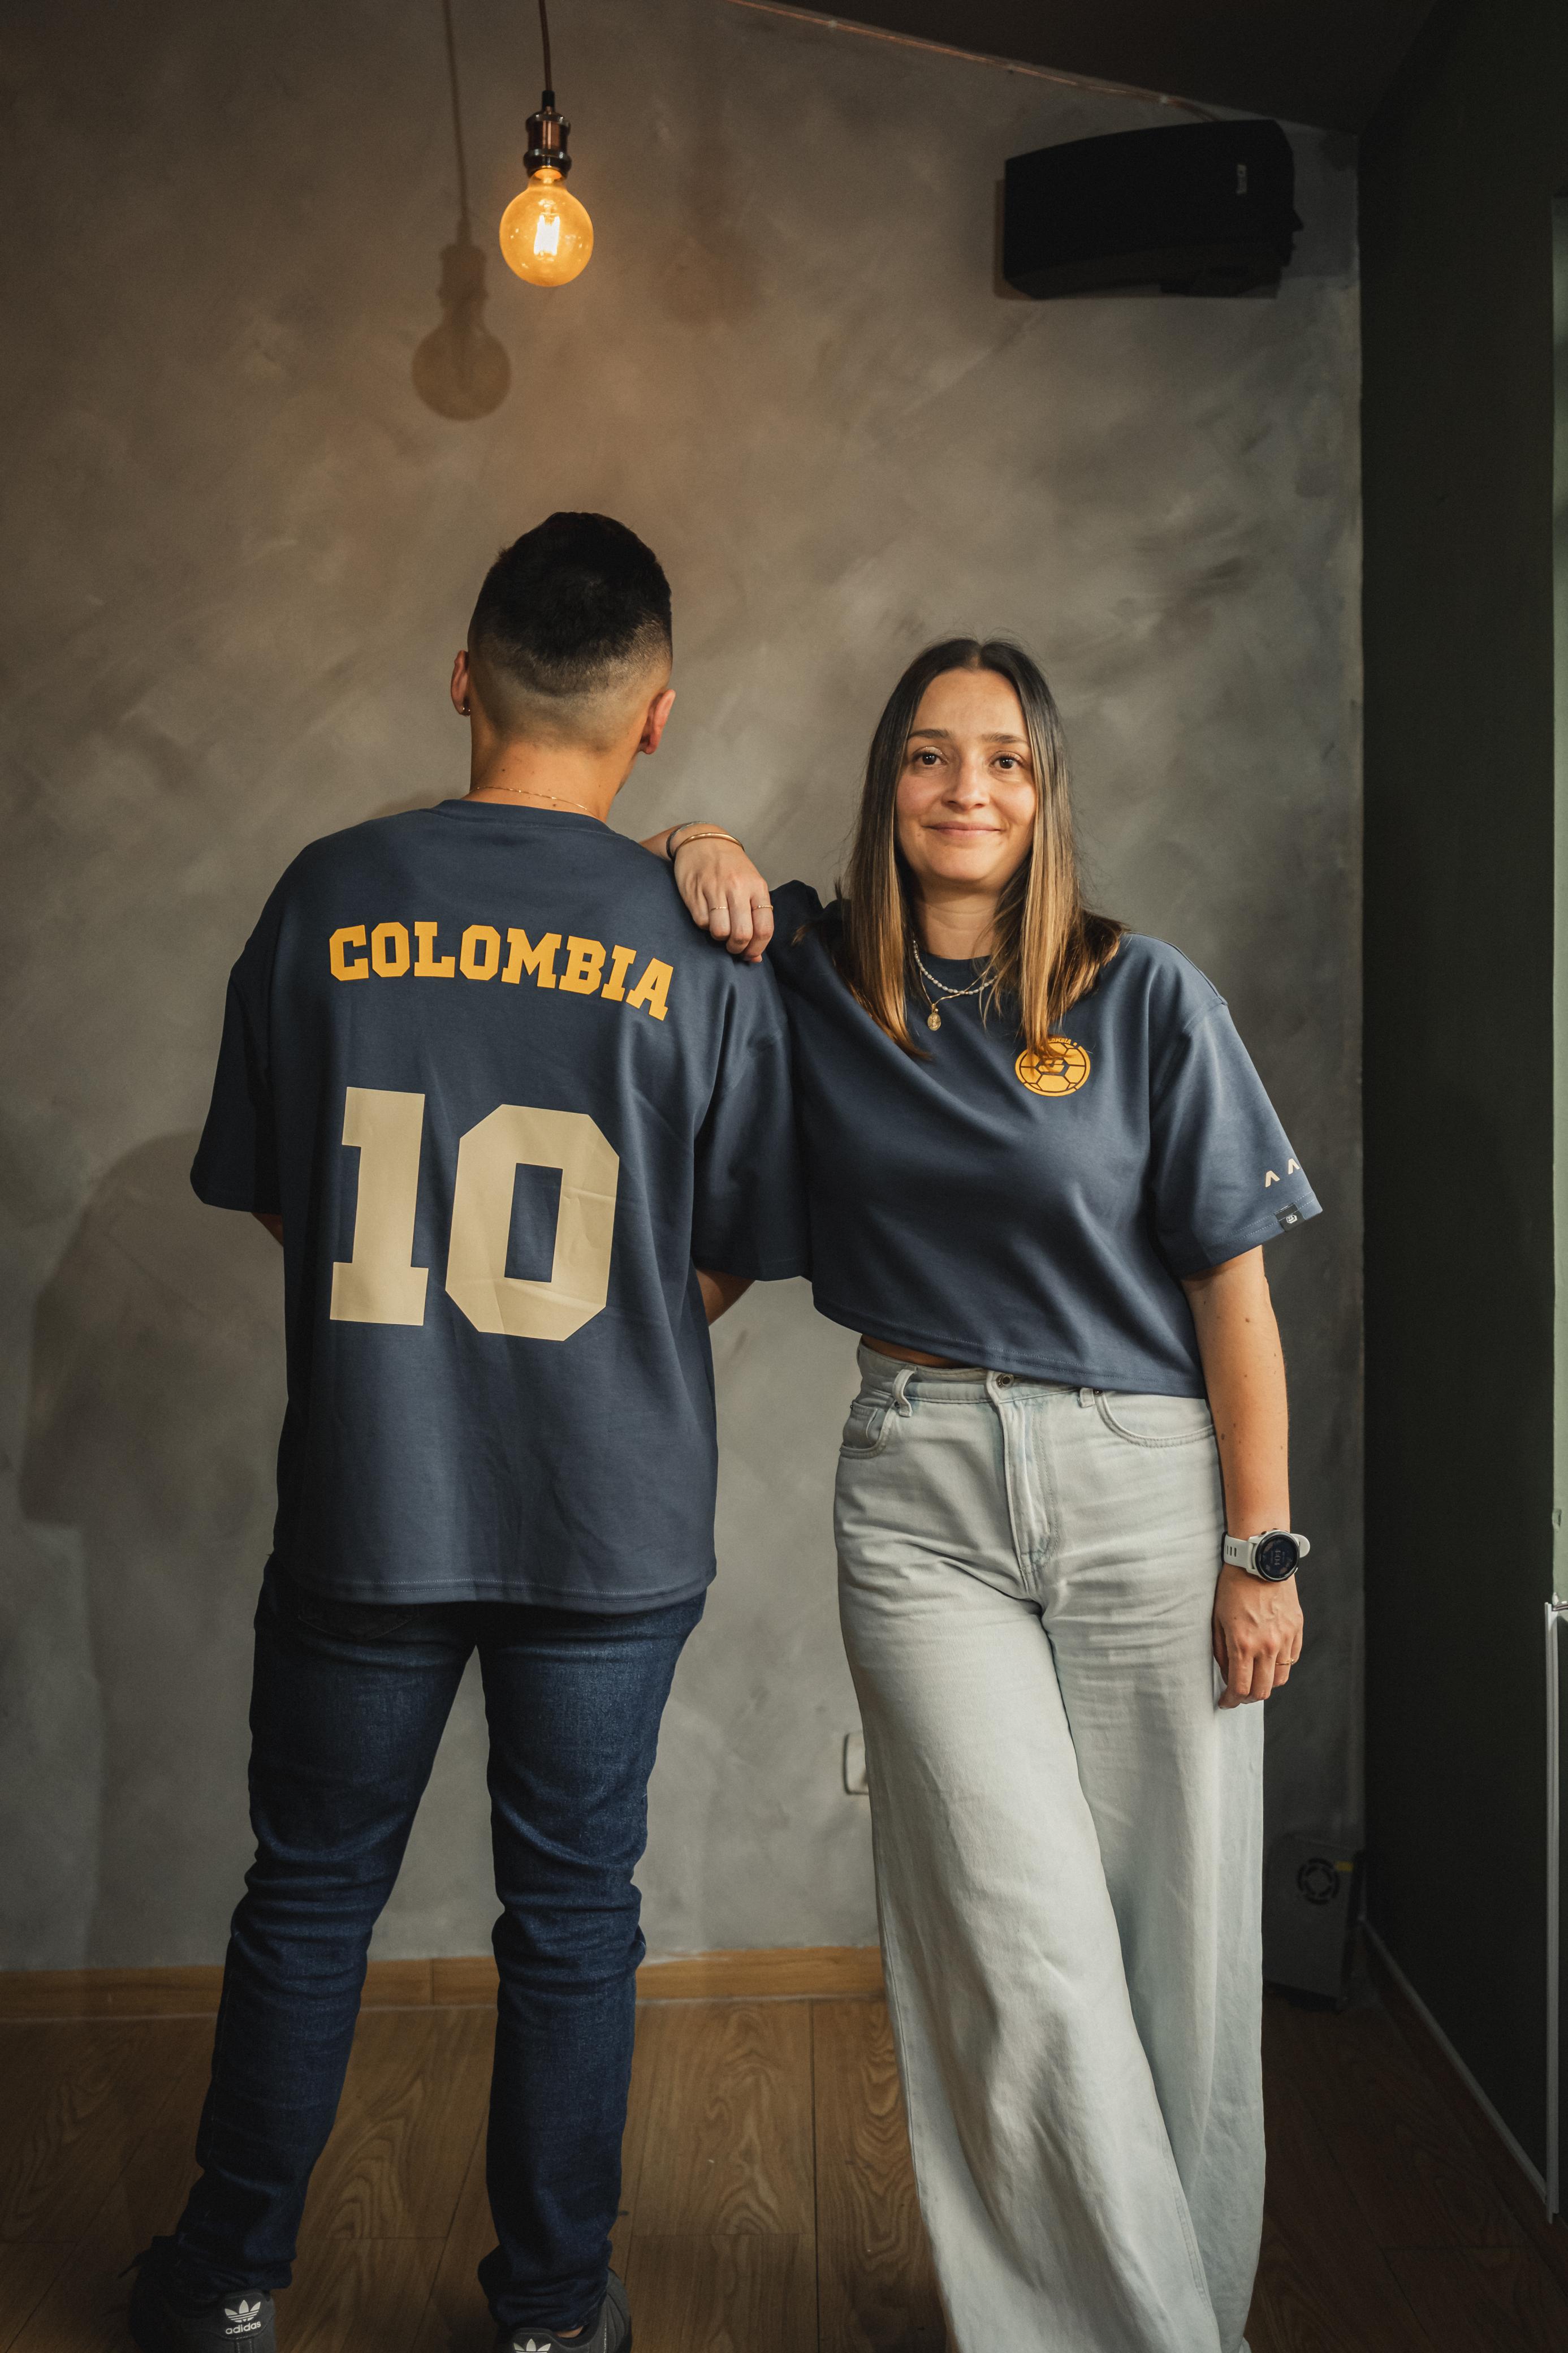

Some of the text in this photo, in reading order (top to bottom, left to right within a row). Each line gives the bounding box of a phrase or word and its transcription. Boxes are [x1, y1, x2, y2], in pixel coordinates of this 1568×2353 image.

[329, 921, 674, 1021] COLOMBIA
[330, 1086, 620, 1342] 10
[225, 2321, 261, 2335] adidas
